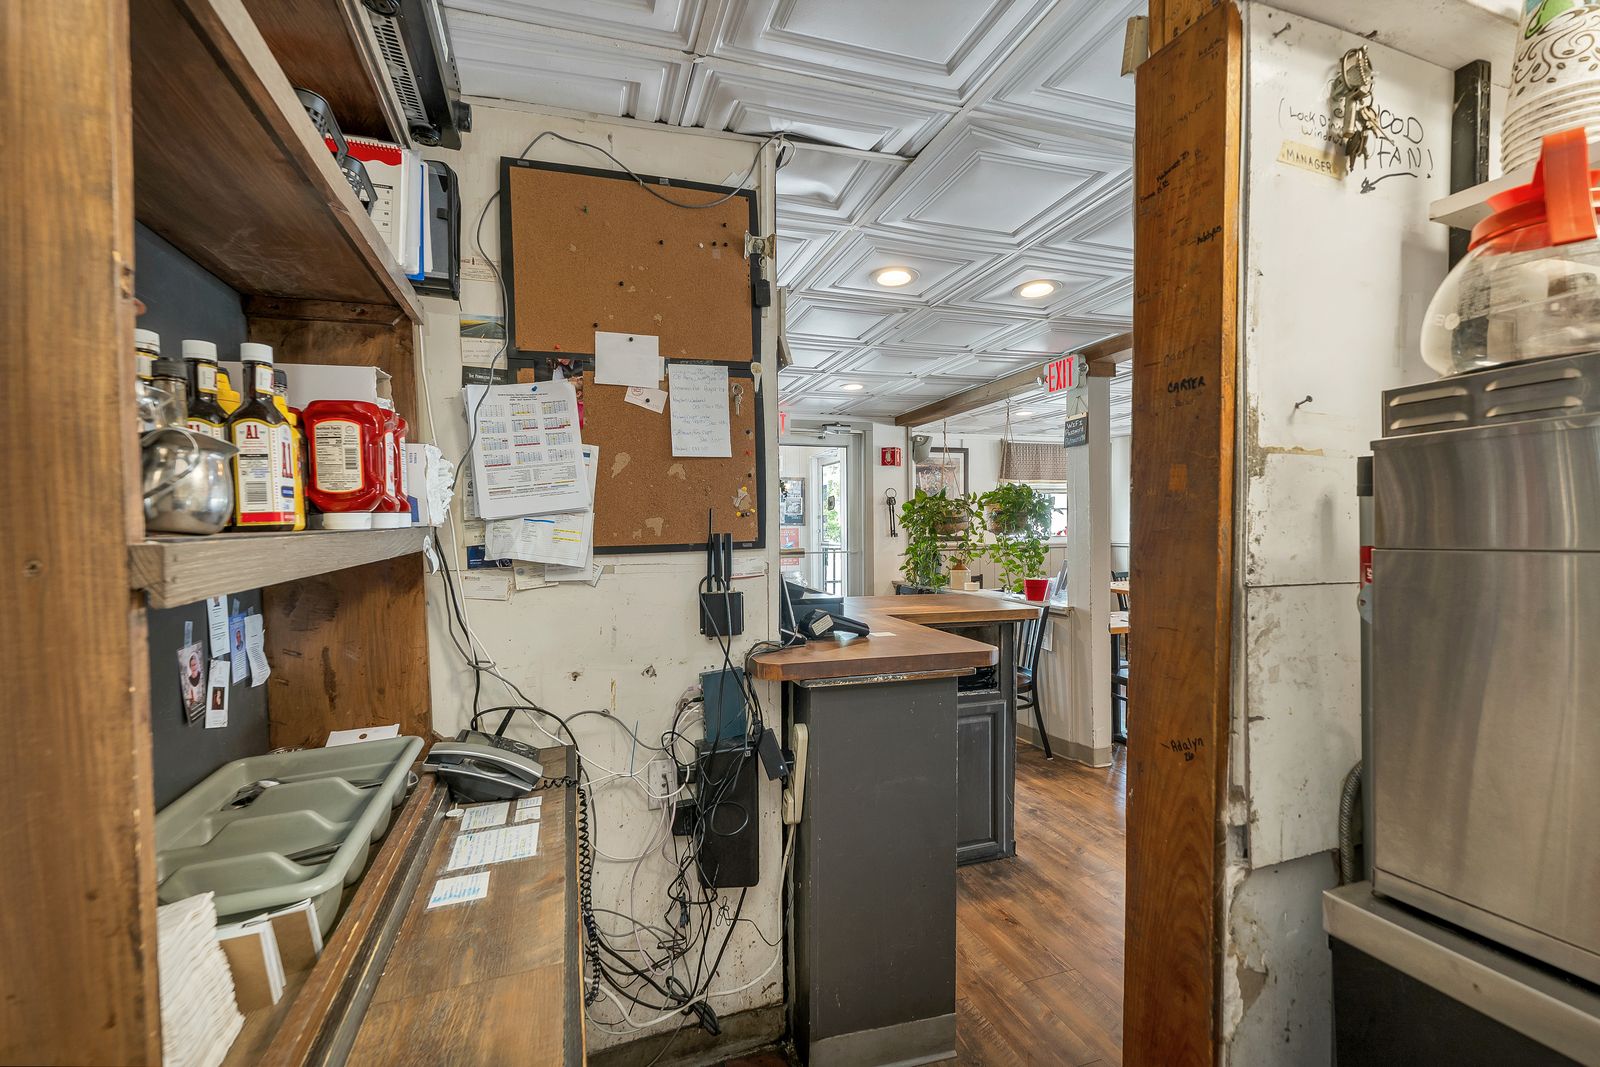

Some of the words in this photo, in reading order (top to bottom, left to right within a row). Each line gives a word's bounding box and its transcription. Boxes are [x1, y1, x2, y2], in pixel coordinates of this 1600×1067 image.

[1378, 105, 1424, 144] OOD
[1286, 149, 1334, 174] MANAGER
[1048, 357, 1074, 392] EXIT
[1167, 376, 1206, 393] CARTER
[1170, 737, 1204, 753] Adalyn
